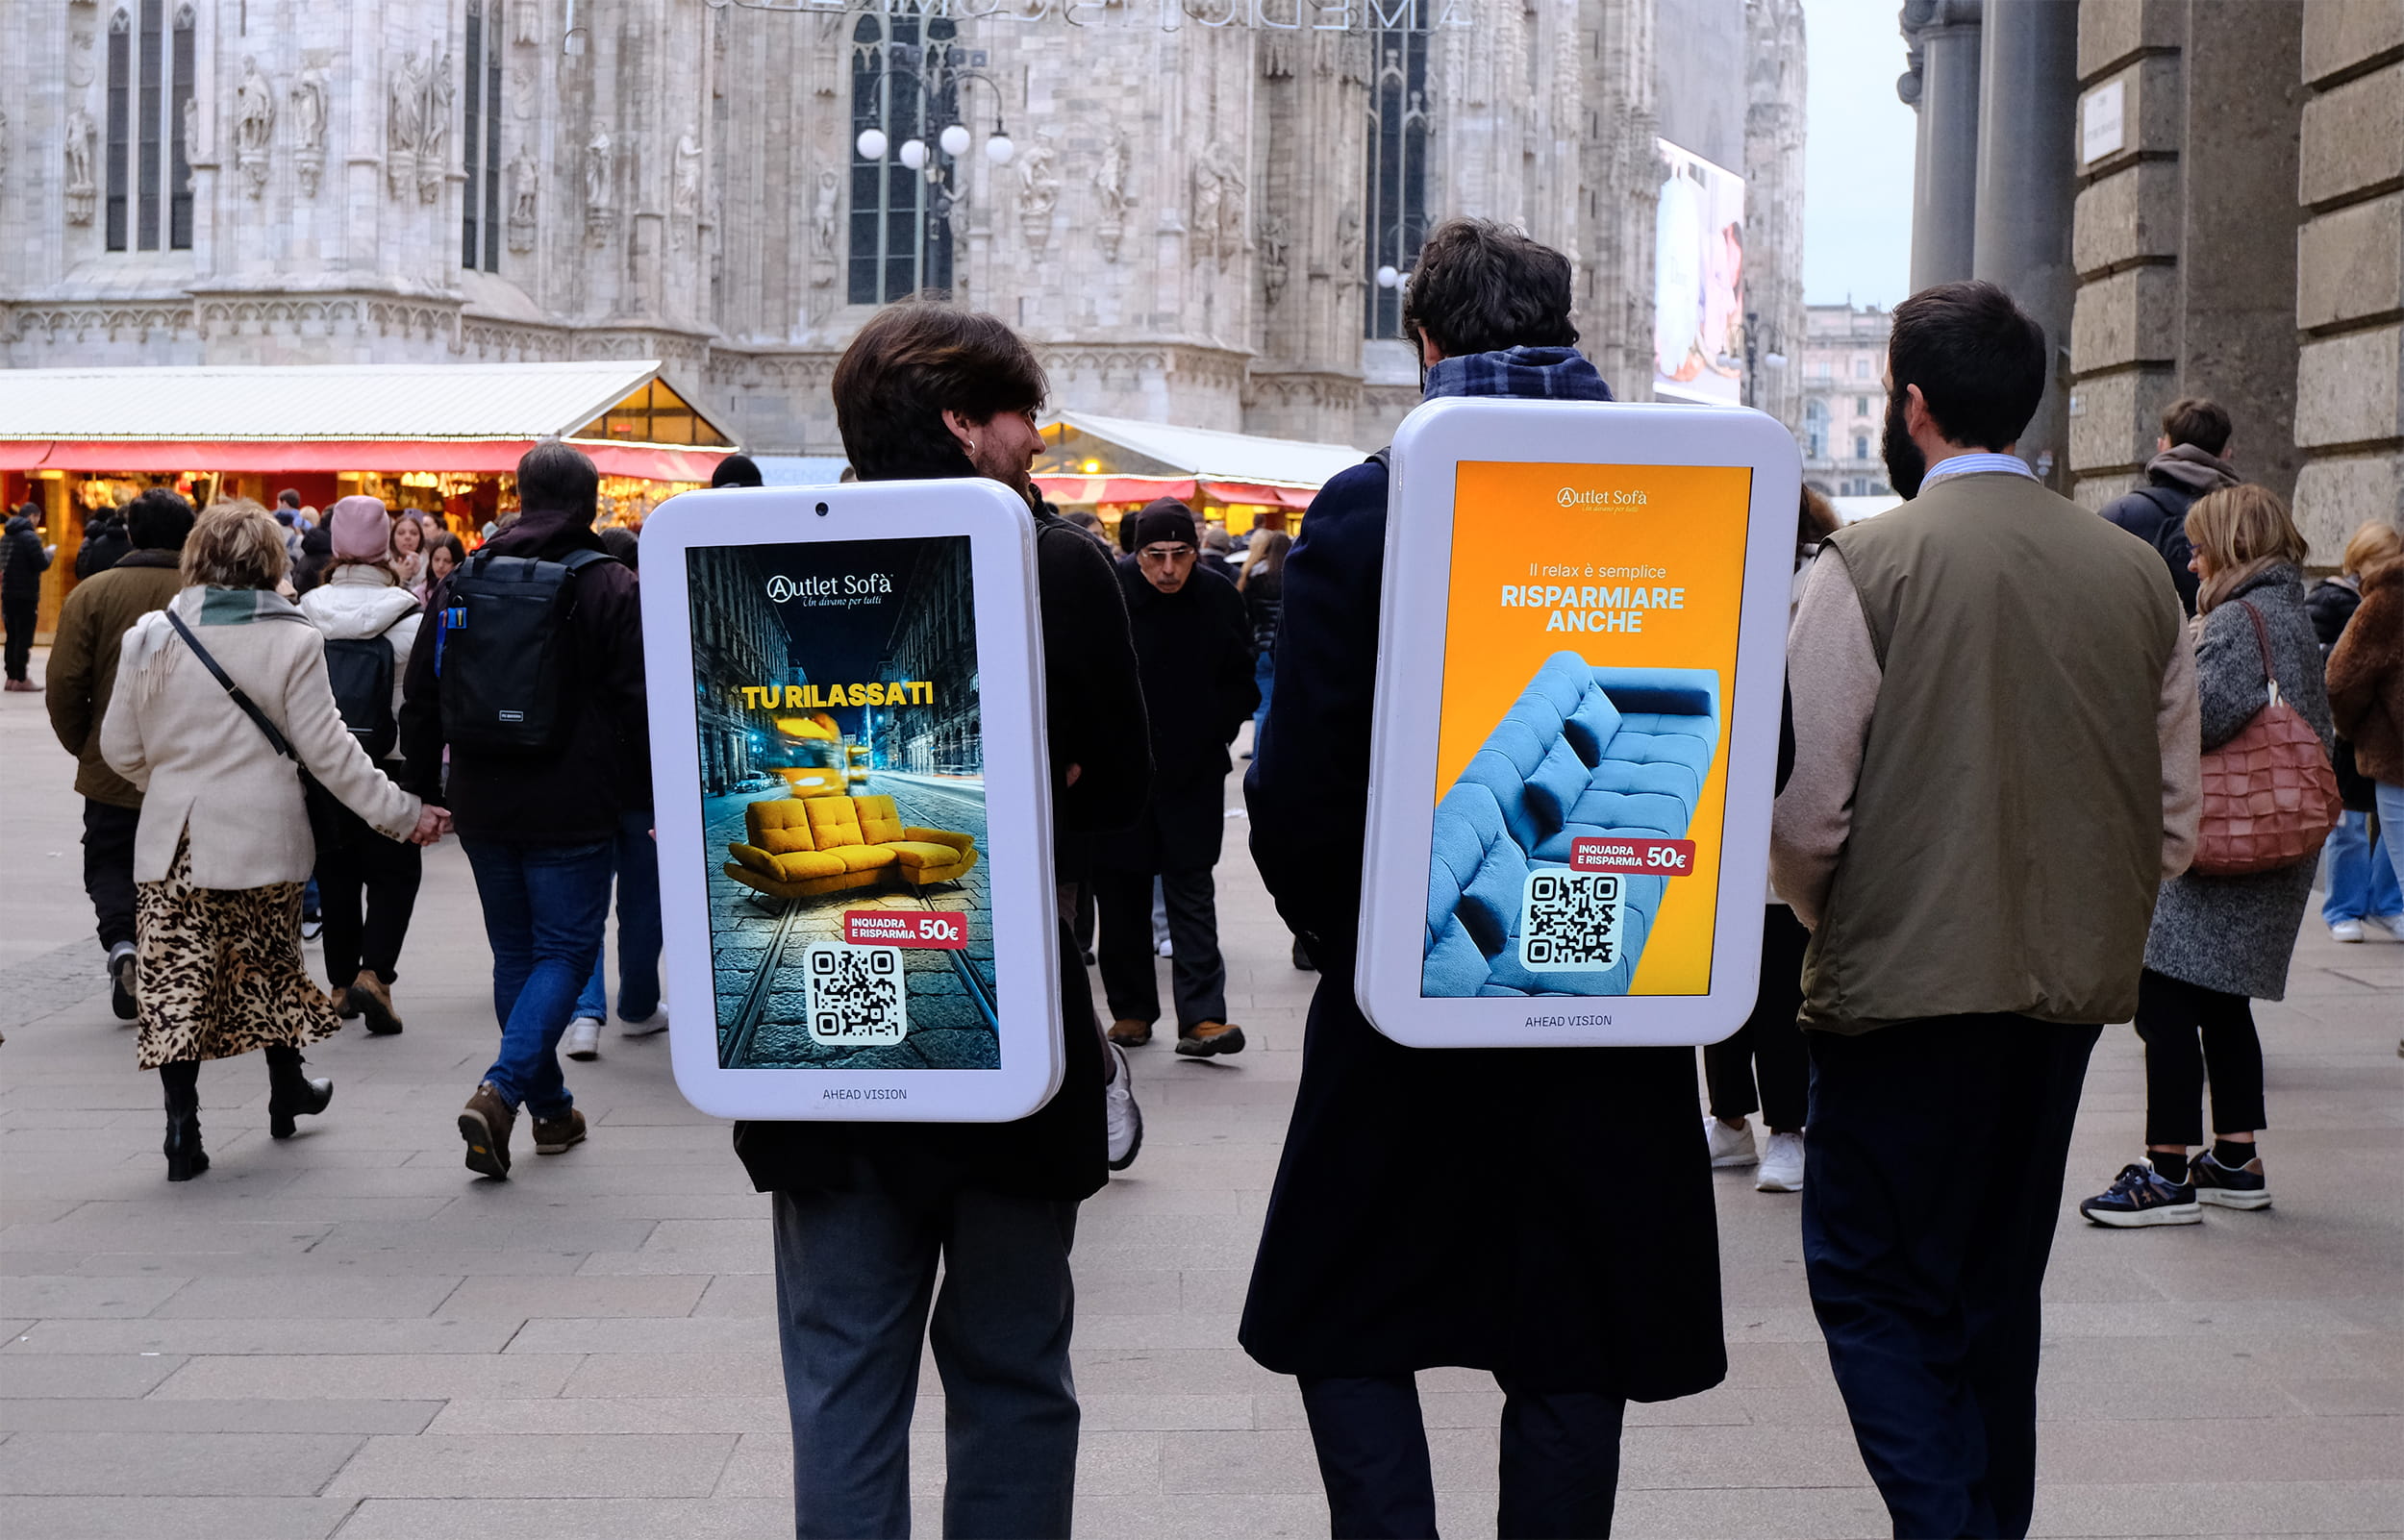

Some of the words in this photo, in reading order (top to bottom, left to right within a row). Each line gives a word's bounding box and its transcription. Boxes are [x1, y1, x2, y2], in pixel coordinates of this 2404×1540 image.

[1613, 489, 1647, 506] Sofà
[1530, 562, 1538, 577] Il
[1542, 563, 1580, 578] relax
[1585, 563, 1593, 578] è
[1598, 563, 1666, 581] semplice
[844, 573, 892, 595] Sofà
[847, 598, 863, 609] per
[1500, 584, 1686, 609] RISPARMIARE
[1545, 610, 1643, 633] ANCHE
[741, 685, 780, 709] TU
[785, 681, 934, 708] RILASSATI
[1578, 844, 1634, 856] INQUADRA
[1646, 846, 1687, 869] 50€
[1577, 856, 1584, 864] E
[1585, 856, 1642, 866] RISPARMIA
[851, 918, 906, 929] INQUADRA
[919, 919, 959, 941] 50€
[852, 929, 858, 937] E
[860, 929, 915, 939] RISPARMIA
[1525, 1016, 1565, 1028] AHEAD
[1567, 1015, 1612, 1027] VISION
[822, 1089, 861, 1100] AHEAD
[864, 1089, 907, 1100] VISION
